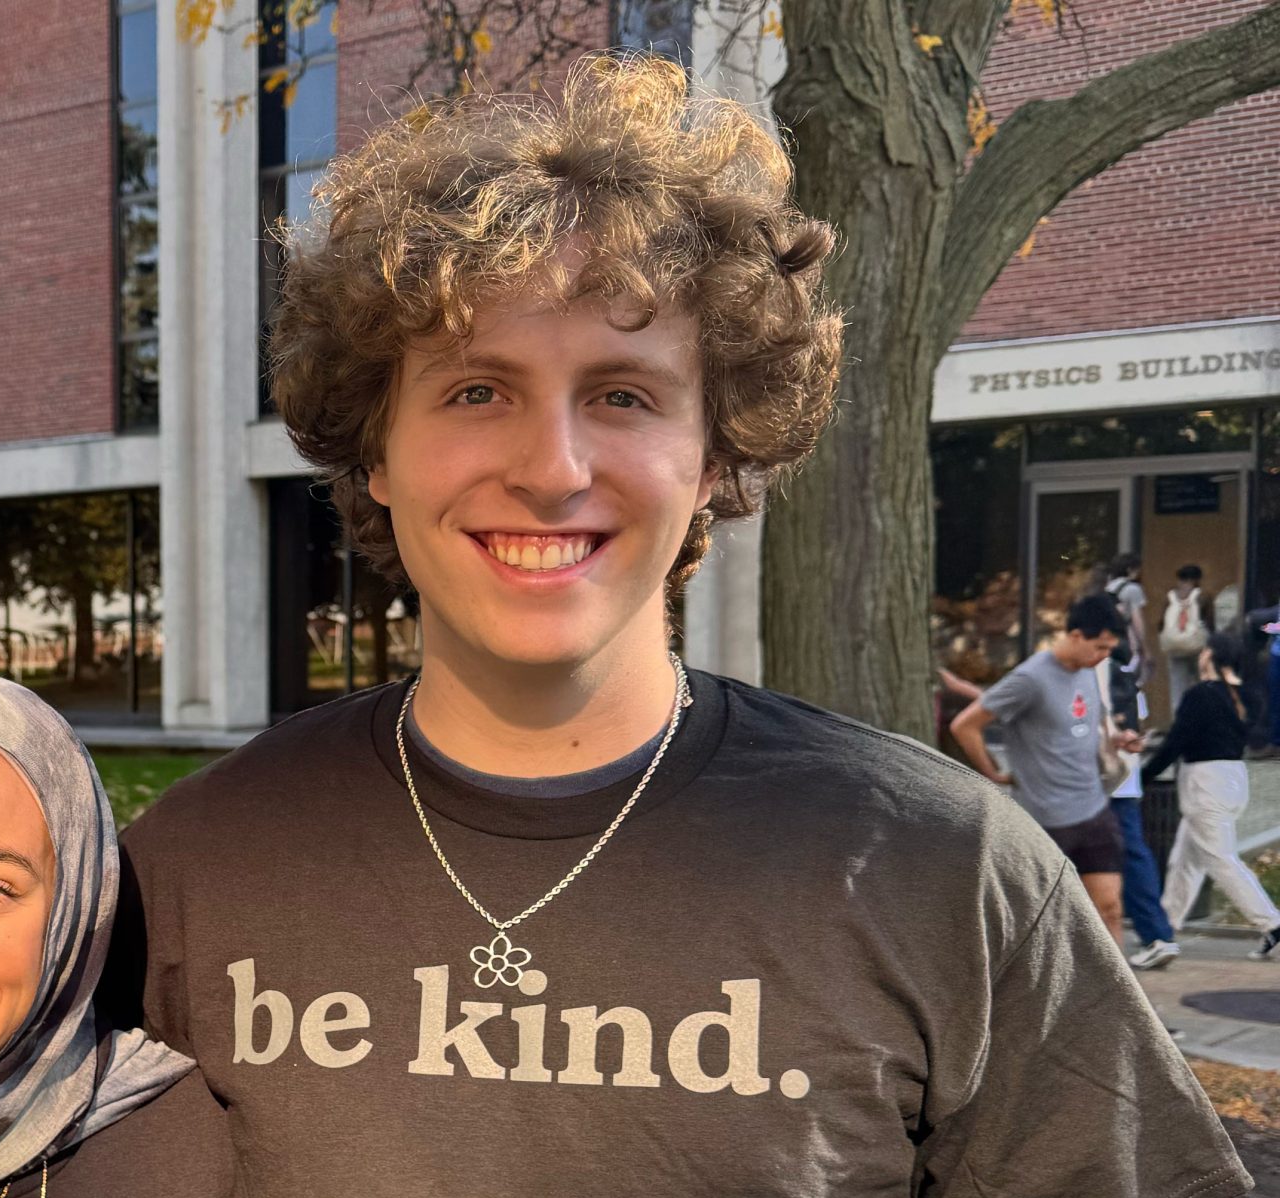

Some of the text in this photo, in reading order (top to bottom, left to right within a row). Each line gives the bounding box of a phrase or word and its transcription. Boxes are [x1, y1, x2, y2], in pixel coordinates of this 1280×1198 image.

[969, 349, 1280, 394] PHYSICS BUILDING
[226, 958, 811, 1099] be kind.
